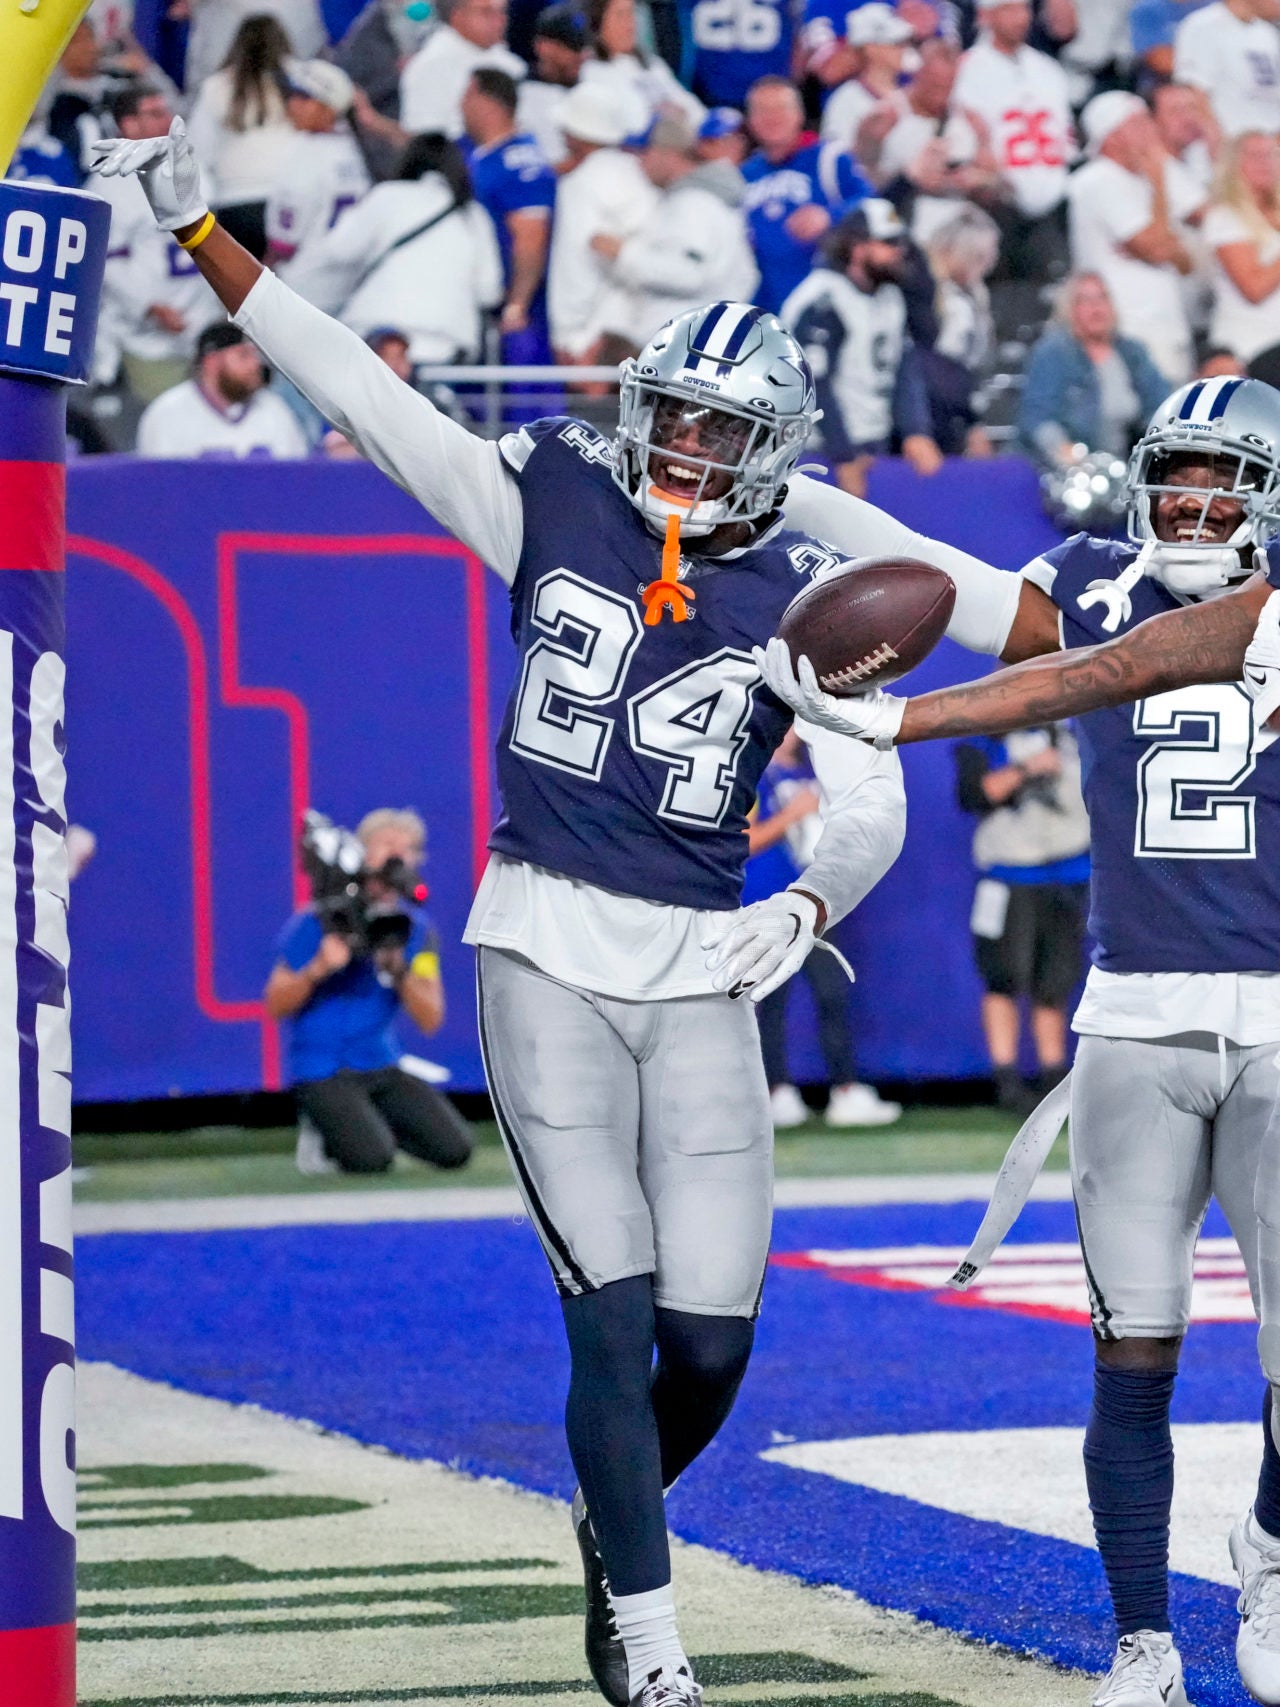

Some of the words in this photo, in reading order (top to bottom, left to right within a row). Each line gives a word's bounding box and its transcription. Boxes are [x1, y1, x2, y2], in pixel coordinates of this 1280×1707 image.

[683, 375, 721, 391] COWBOYS
[509, 567, 766, 830] 24
[1133, 680, 1256, 860] 2
